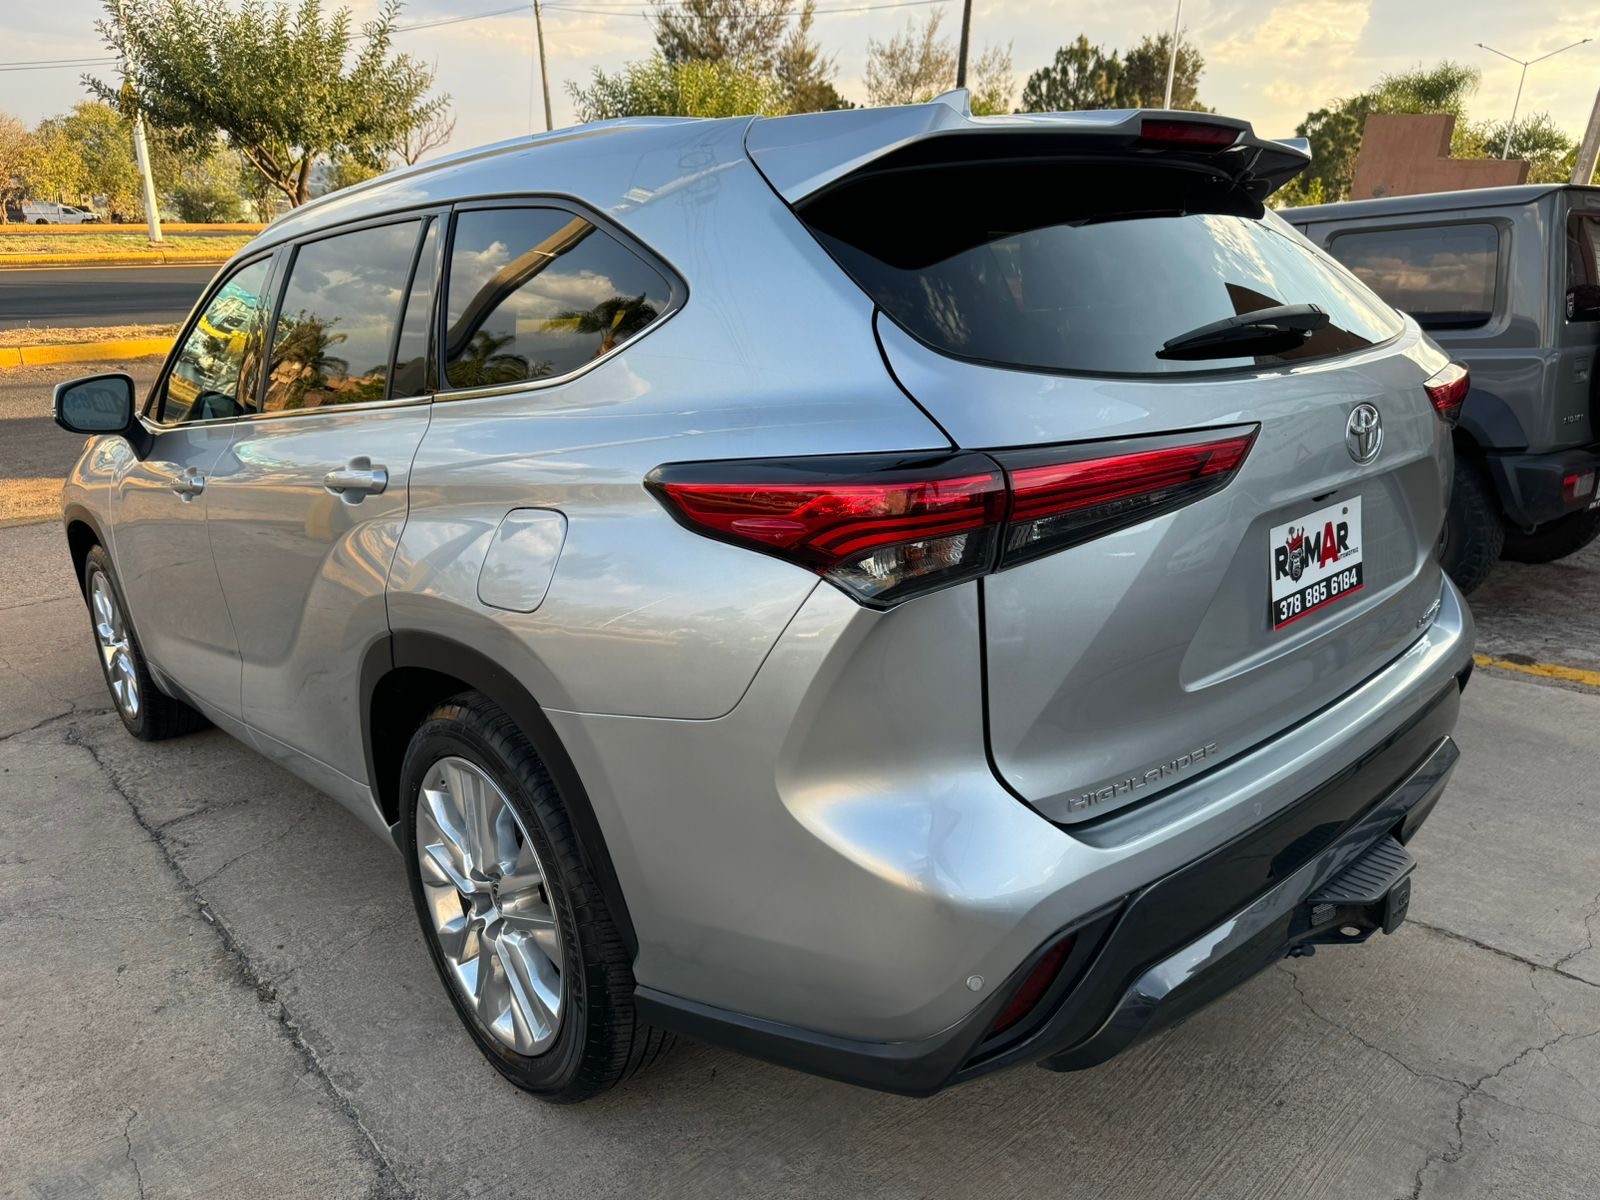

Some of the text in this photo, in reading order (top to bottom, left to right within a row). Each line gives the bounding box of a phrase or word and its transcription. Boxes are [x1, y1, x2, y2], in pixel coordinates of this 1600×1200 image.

[1280, 568, 1358, 620] 378 885 6184
[1067, 742, 1217, 813] HIGHLANDER
